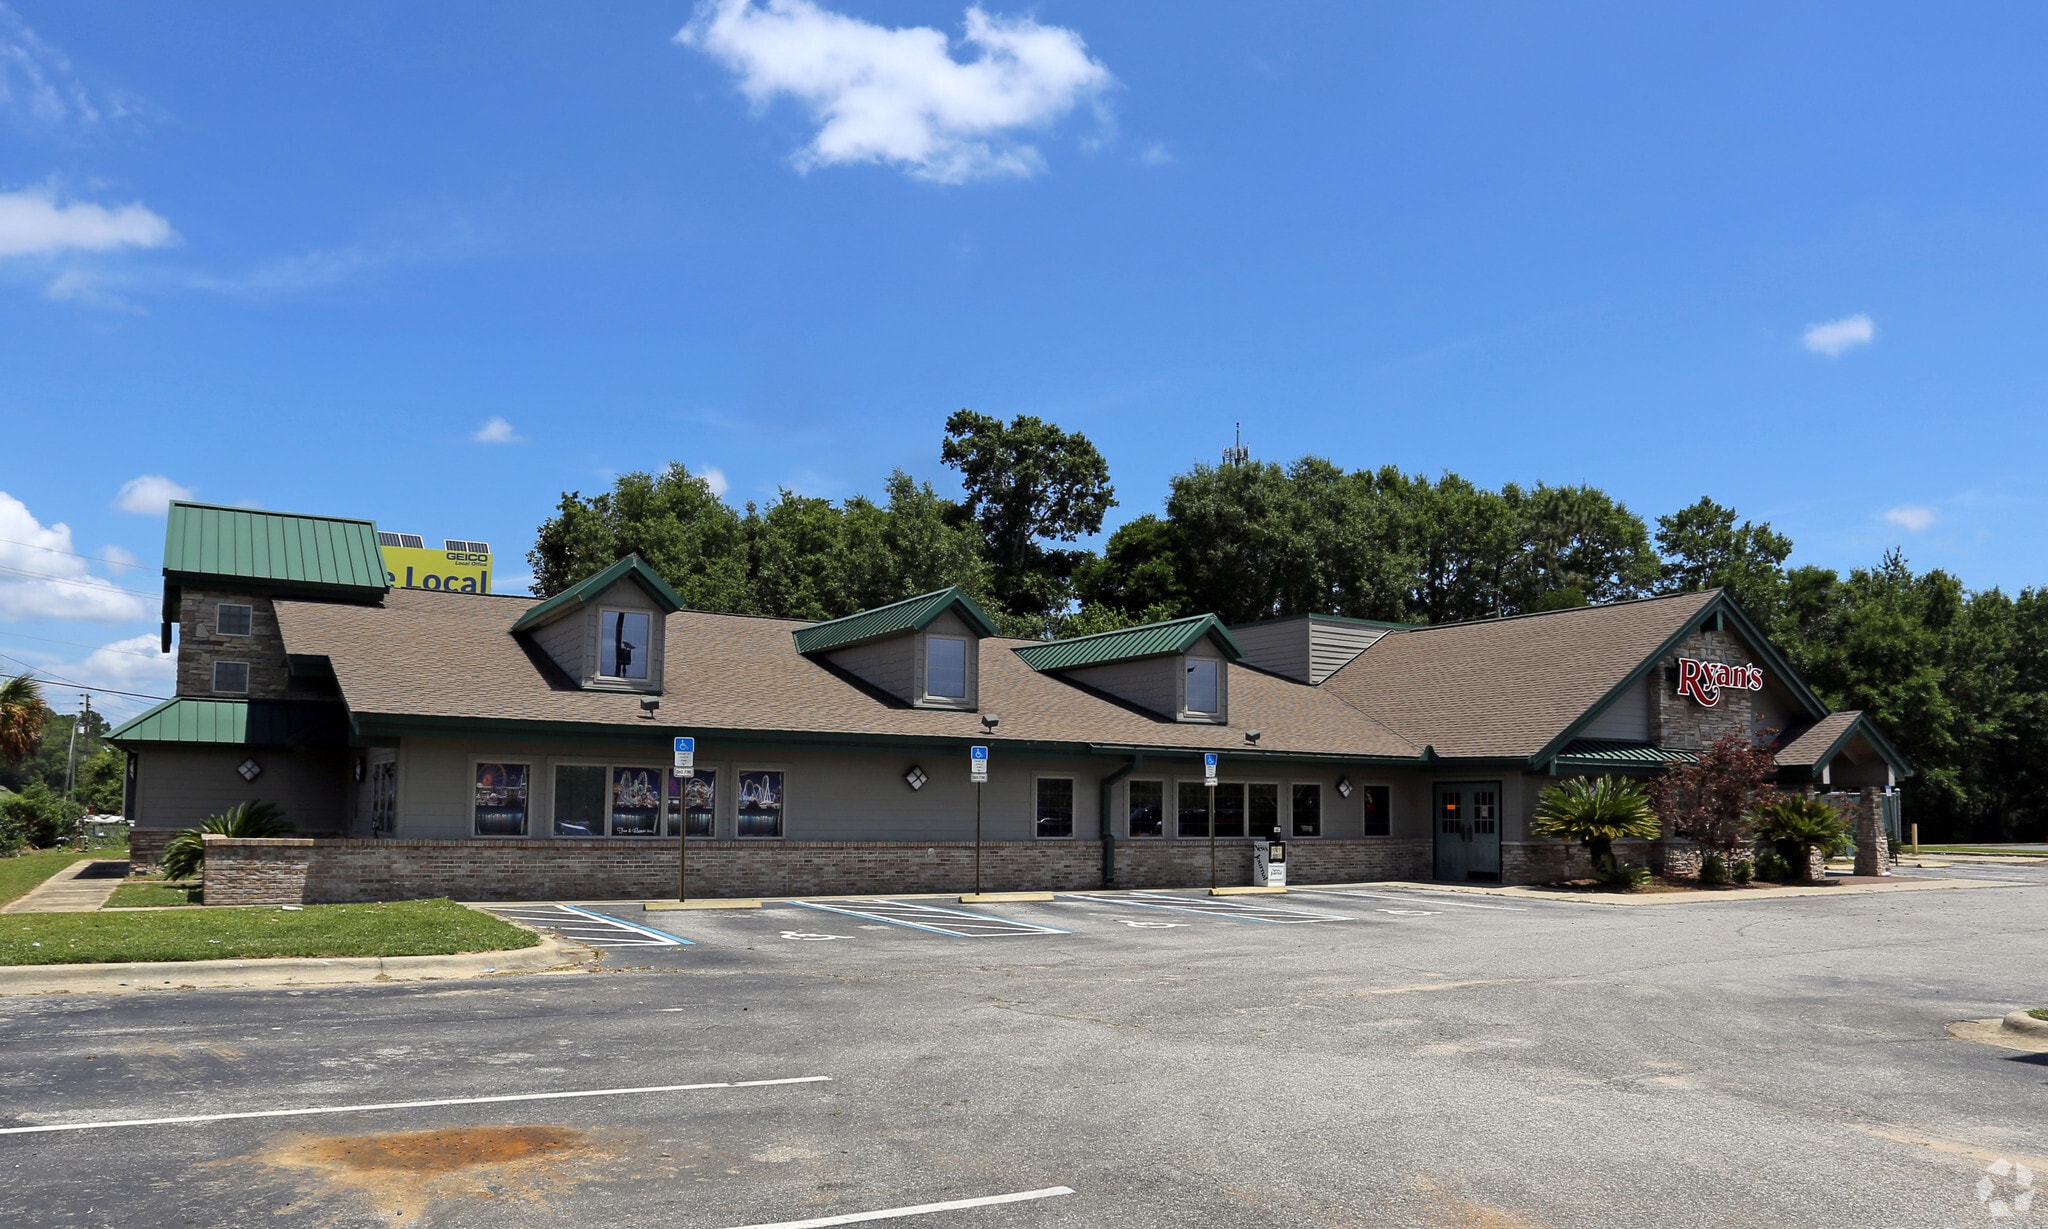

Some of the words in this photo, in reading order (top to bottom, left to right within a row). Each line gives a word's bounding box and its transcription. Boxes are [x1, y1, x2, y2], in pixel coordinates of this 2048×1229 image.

[446, 552, 488, 562] GEICO
[406, 566, 487, 594] Local
[1677, 657, 1763, 707] Ryan's
